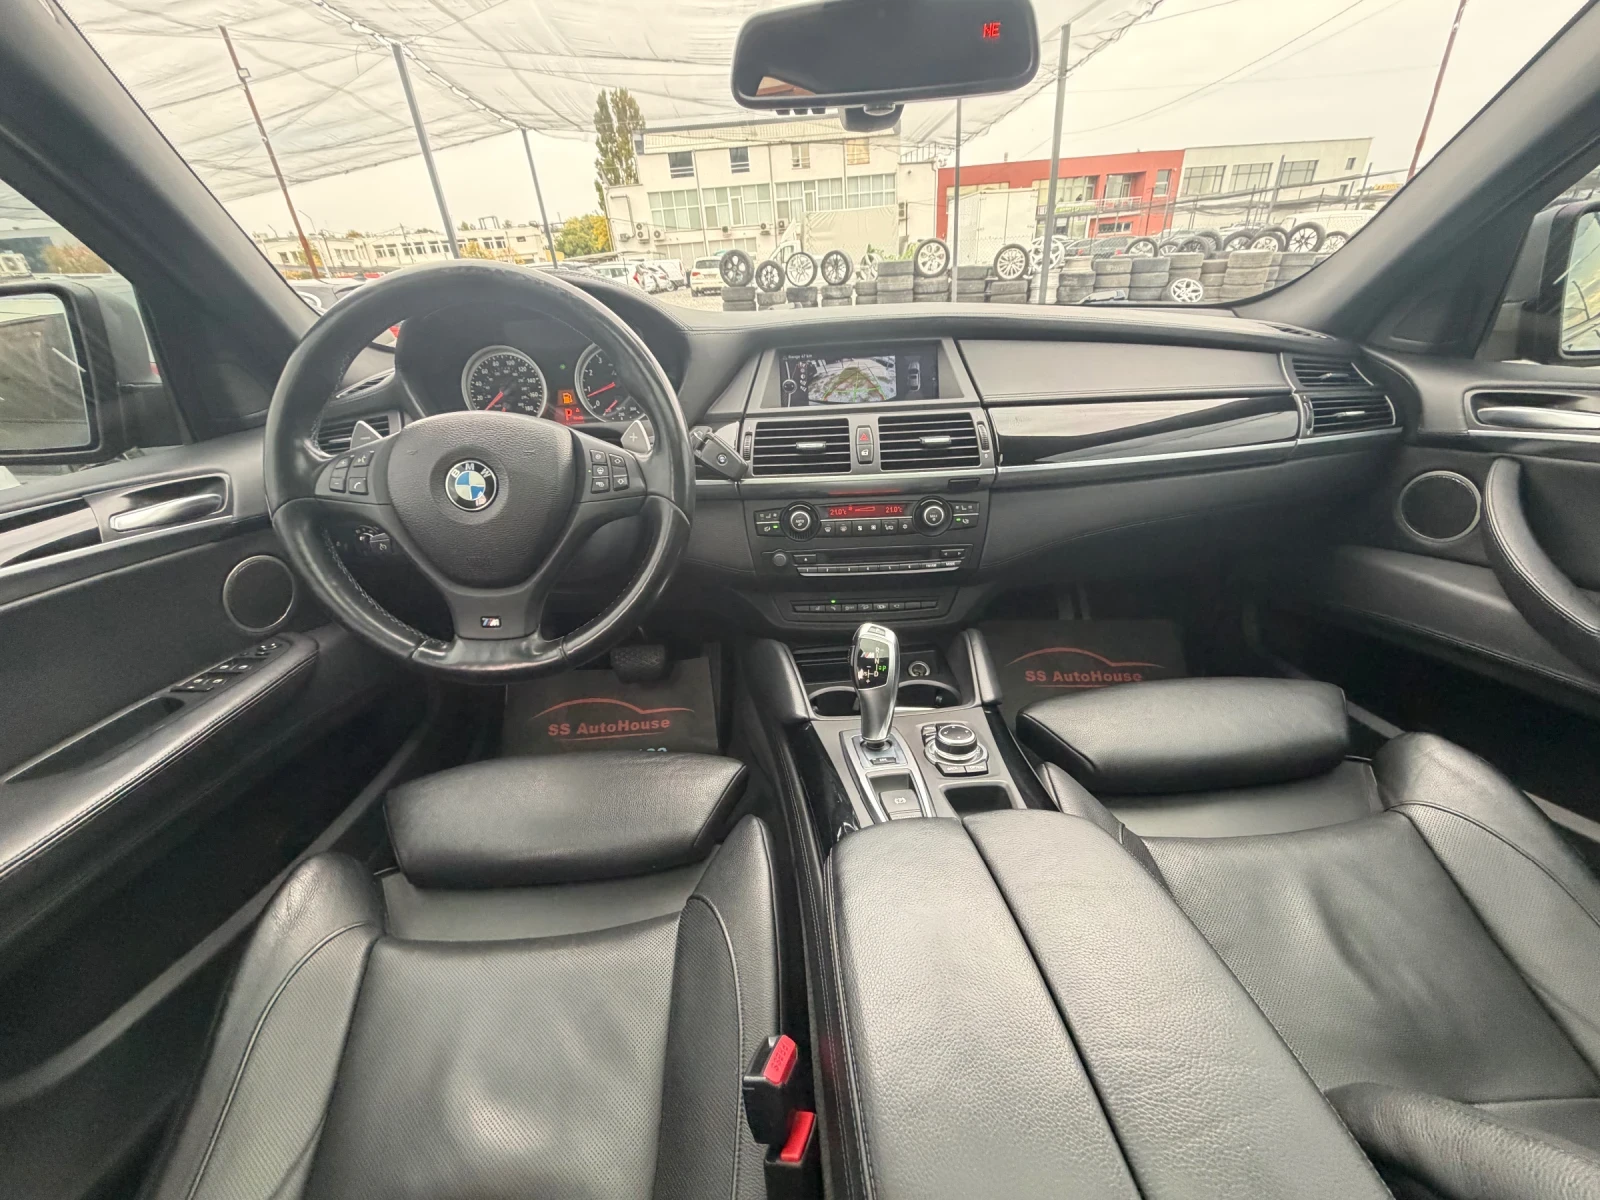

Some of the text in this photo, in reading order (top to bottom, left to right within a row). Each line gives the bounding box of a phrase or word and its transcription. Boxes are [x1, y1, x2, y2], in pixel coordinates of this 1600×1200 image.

[982, 22, 1001, 38] NE
[588, 369, 593, 377] 2
[564, 408, 573, 421] P
[450, 462, 492, 479] BMW
[1025, 670, 1143, 683] SS AutoHouse
[547, 718, 671, 736] SS AutoHouse
